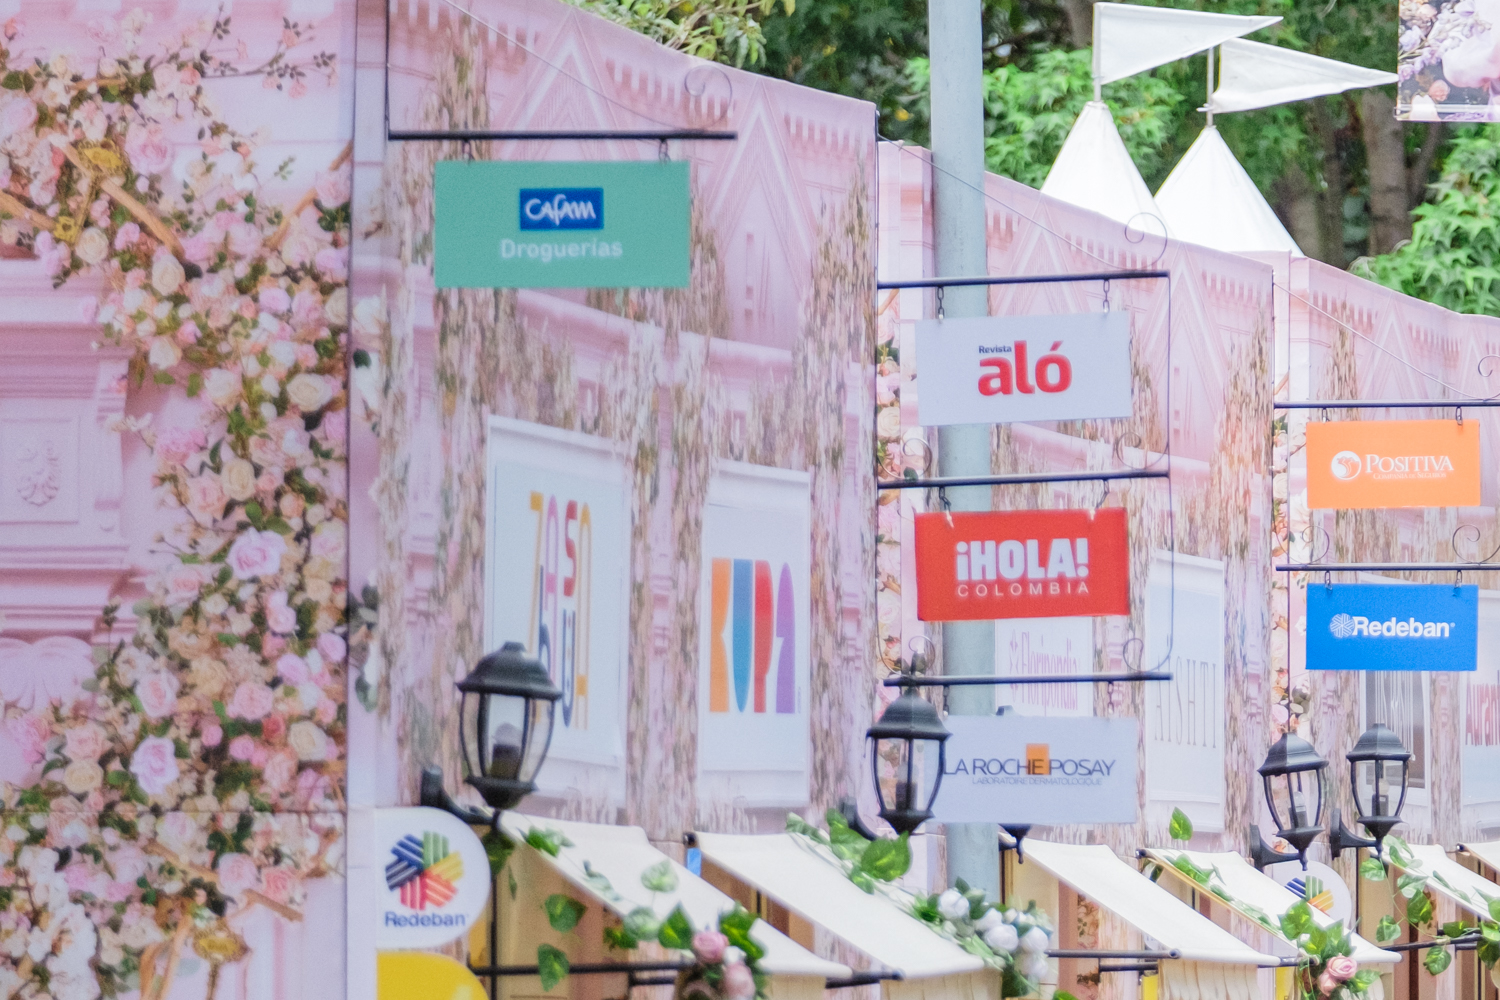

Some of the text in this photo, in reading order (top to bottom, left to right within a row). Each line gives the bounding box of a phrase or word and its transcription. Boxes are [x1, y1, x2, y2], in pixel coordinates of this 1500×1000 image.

[500, 238, 623, 263] Droguerías
[978, 345, 1012, 354] Revista
[978, 340, 1072, 396] aló
[956, 537, 1089, 581] ¡HOLA!
[957, 582, 1089, 597] COLOMBIA
[1352, 616, 1450, 637] Redeban
[943, 758, 1116, 776] LA ROCHE POSAY
[384, 911, 466, 927] Redeban
